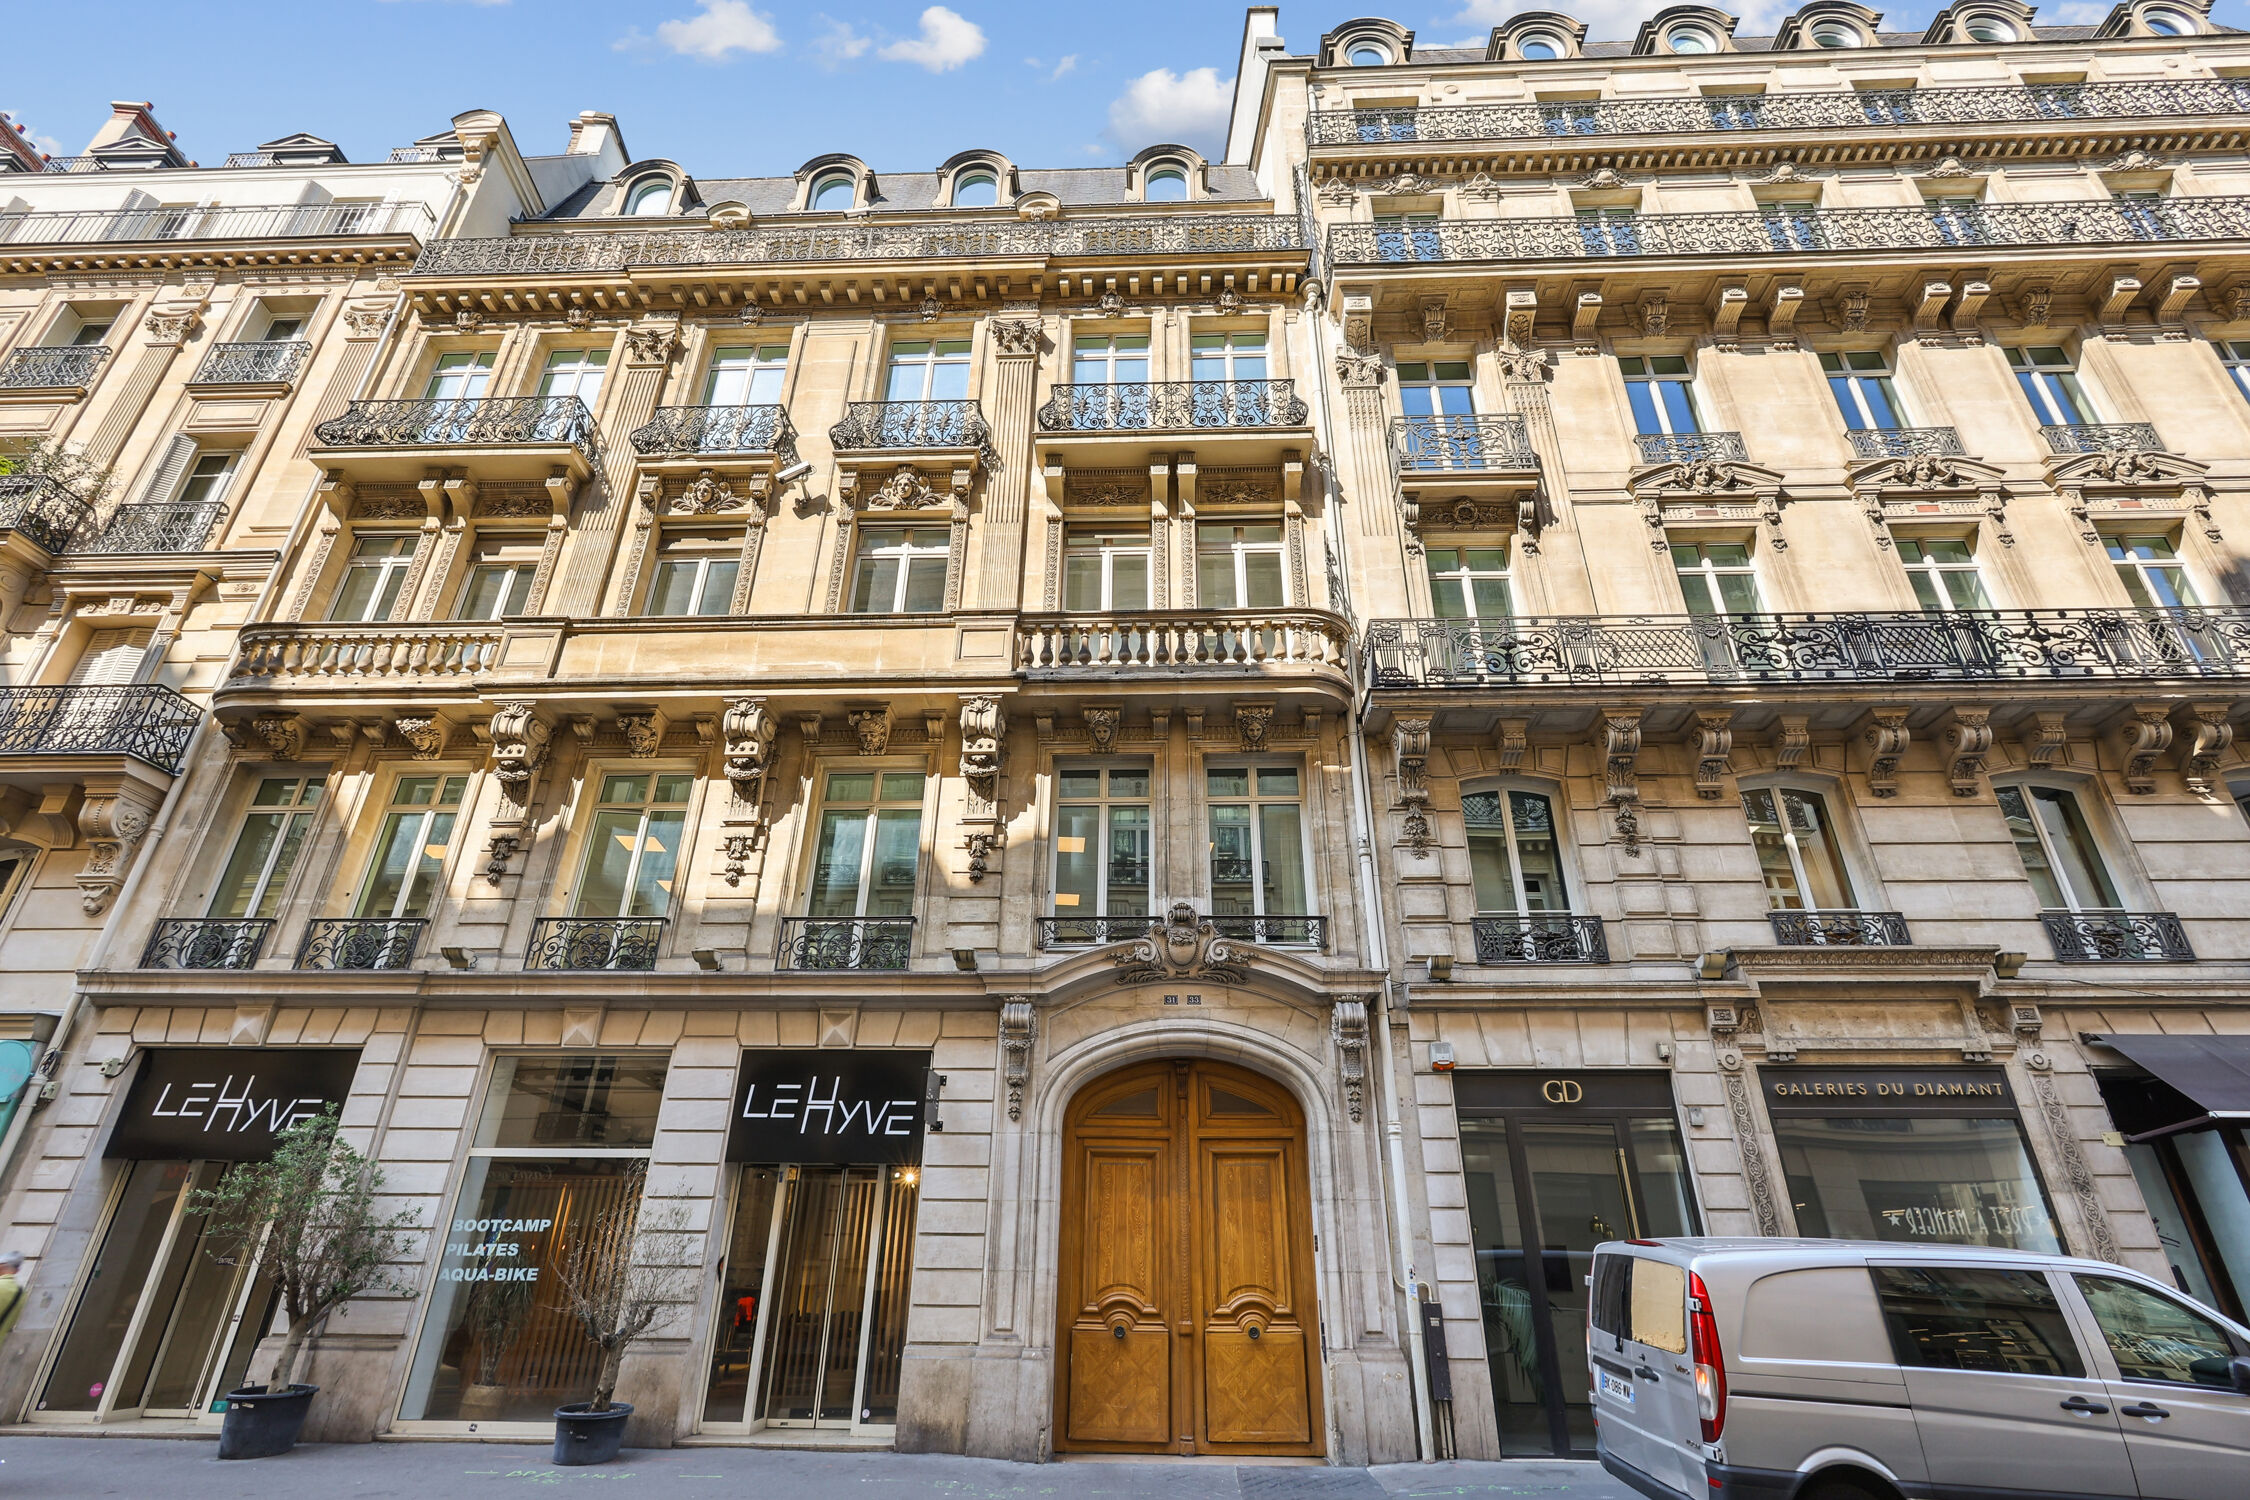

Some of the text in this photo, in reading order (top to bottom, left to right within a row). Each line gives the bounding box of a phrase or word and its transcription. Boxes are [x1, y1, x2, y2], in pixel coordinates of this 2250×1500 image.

[1543, 1080, 1582, 1103] GD
[1775, 1083, 2003, 1096] GALERIES DU DIAMANT
[452, 1219, 551, 1232] BOOTCAMP
[444, 1243, 519, 1256] PILATES
[438, 1268, 539, 1282] AQUA-BIKE
